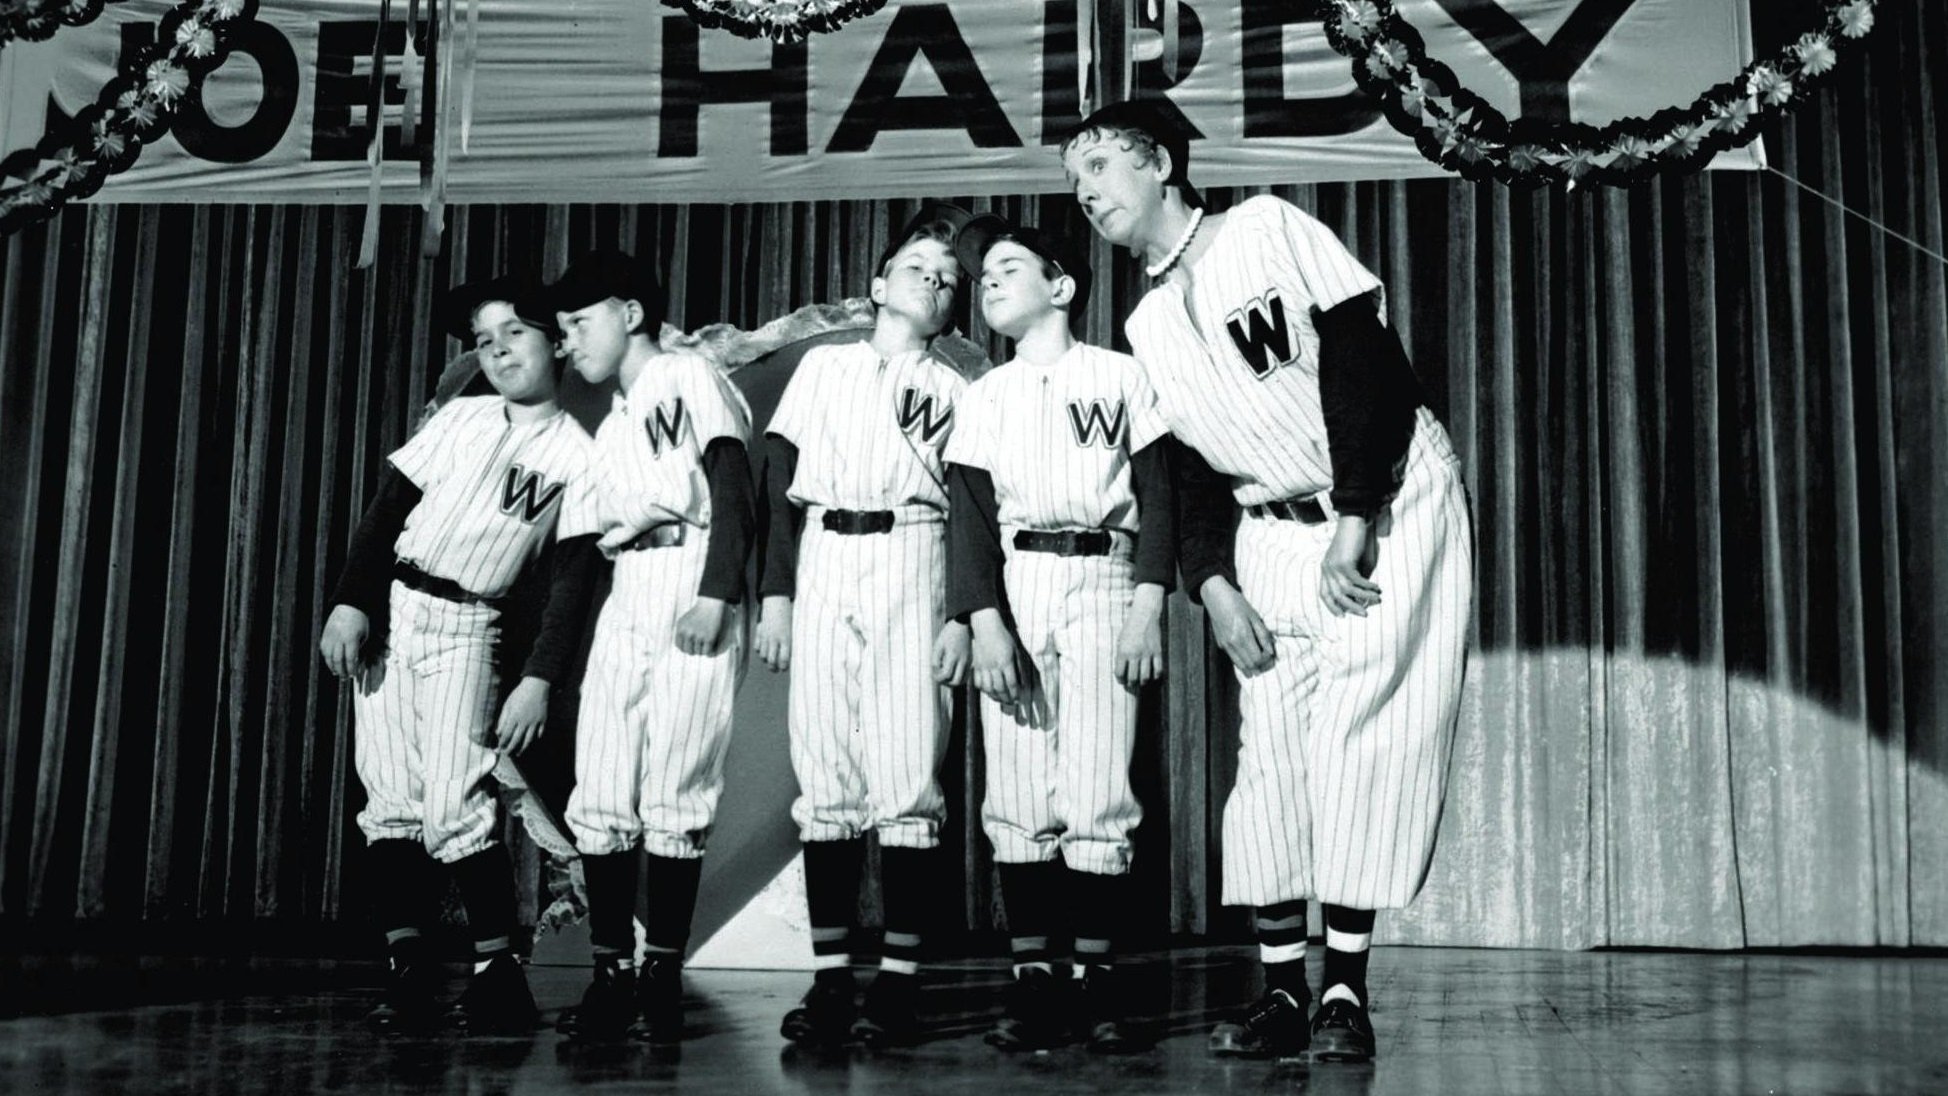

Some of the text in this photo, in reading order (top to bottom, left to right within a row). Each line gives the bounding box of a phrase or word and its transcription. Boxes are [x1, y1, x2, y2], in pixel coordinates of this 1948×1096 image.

[657, 0, 1637, 158] HARDY
[1225, 288, 1300, 381] W
[645, 397, 689, 459] W
[900, 386, 955, 446] W
[1066, 398, 1128, 449] W
[500, 463, 566, 525] W
